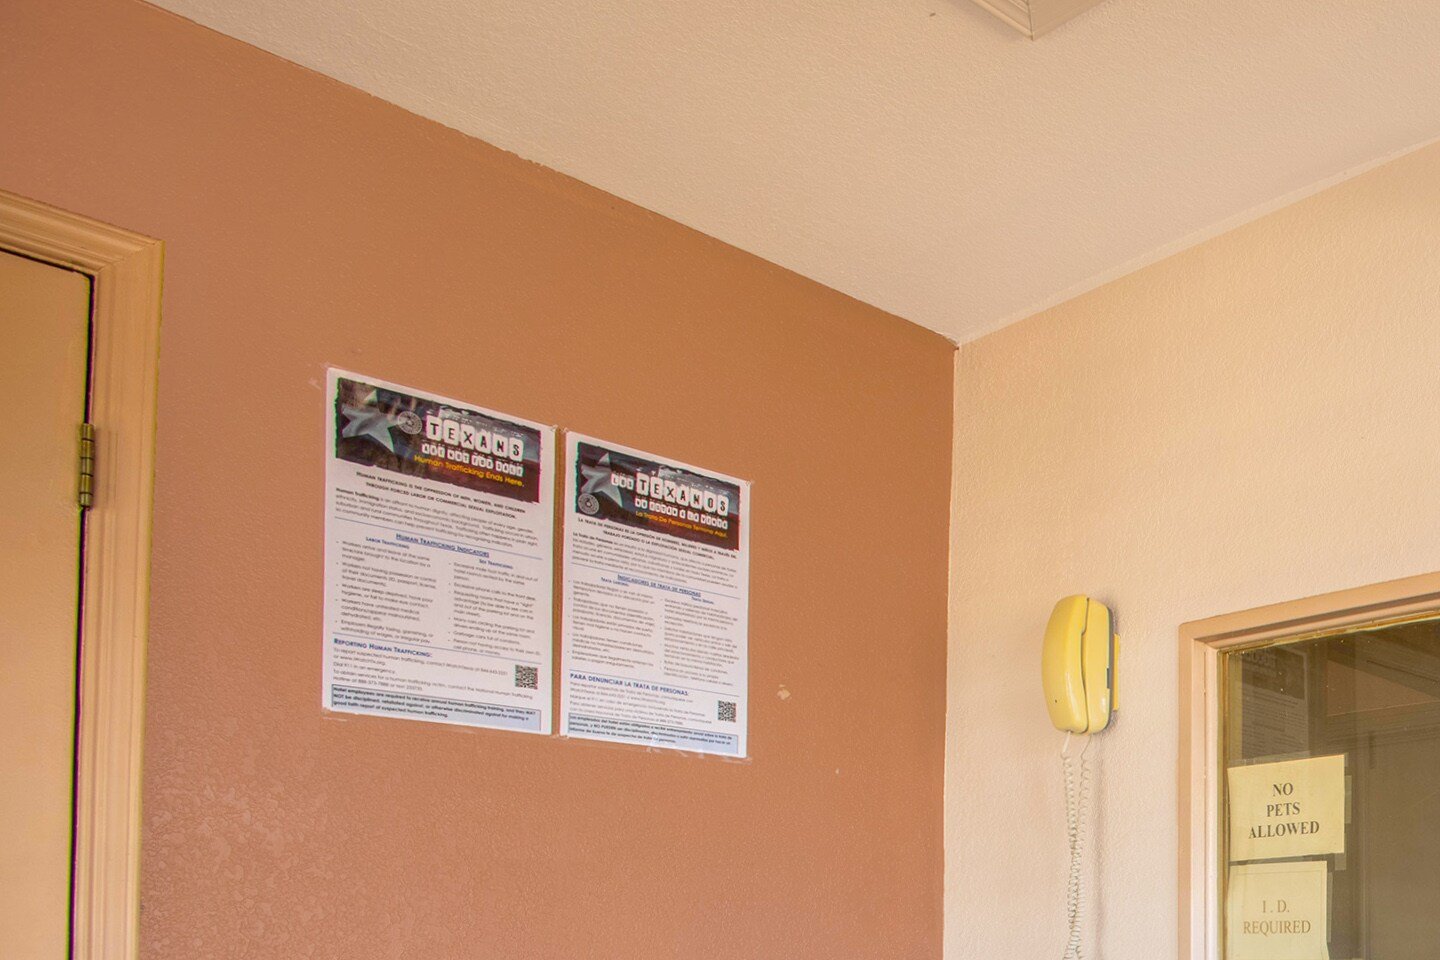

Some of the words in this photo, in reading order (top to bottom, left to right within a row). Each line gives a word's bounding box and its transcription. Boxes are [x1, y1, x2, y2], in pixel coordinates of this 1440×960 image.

[426, 416, 523, 462] TEXANS
[414, 454, 443, 468] Human
[636, 471, 729, 516] TEXANOS
[396, 533, 419, 544] HUMAN
[334, 638, 367, 650] REPORTING
[369, 643, 393, 653] HUMAN
[570, 673, 586, 681] PARA
[588, 675, 623, 686] DENUNCIAR
[1272, 782, 1294, 797] NO
[1266, 802, 1301, 817] PETS
[1248, 820, 1320, 839] ALLOWED
[1243, 919, 1311, 937] REQUIRED
